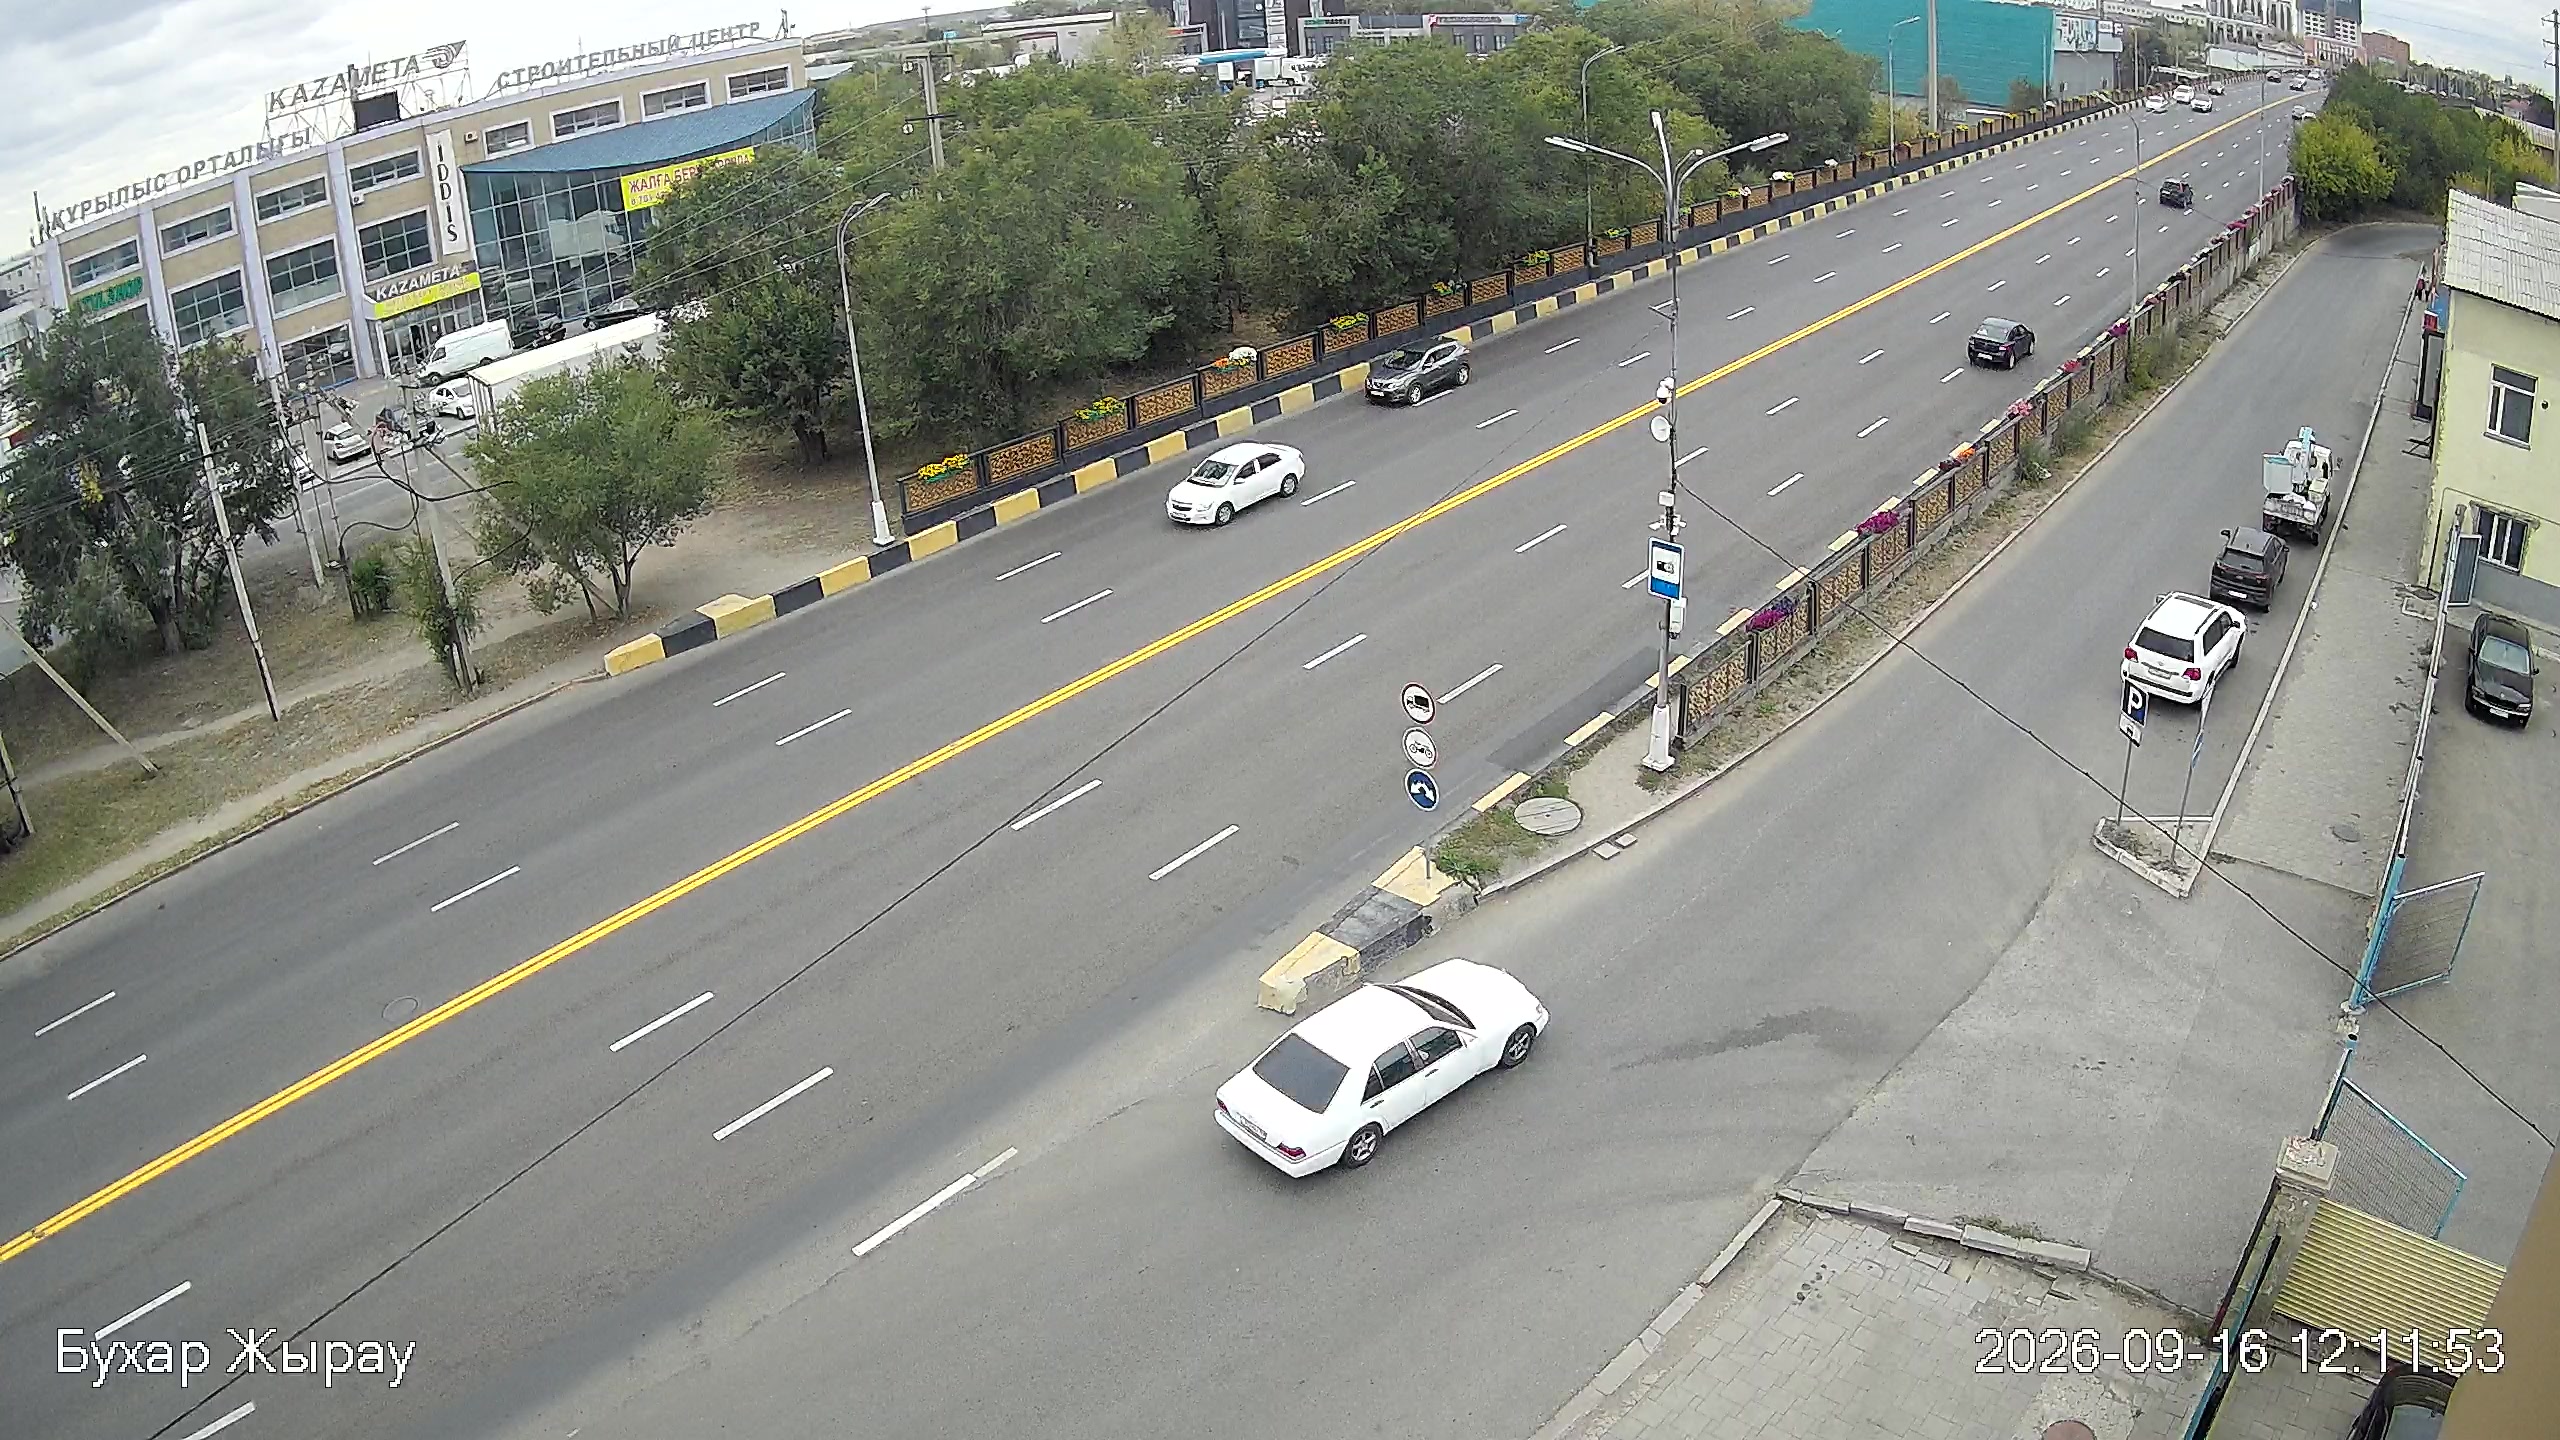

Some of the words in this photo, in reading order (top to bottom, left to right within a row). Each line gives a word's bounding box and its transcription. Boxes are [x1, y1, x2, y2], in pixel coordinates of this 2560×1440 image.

[497, 34, 680, 89] СТРОИТЕЛЬНЫЙ
[691, 22, 759, 51] ЦЕНТР
[269, 54, 420, 112] KAZAMETA
[376, 263, 460, 300] KAZAMETA
[2127, 683, 2143, 714] P
